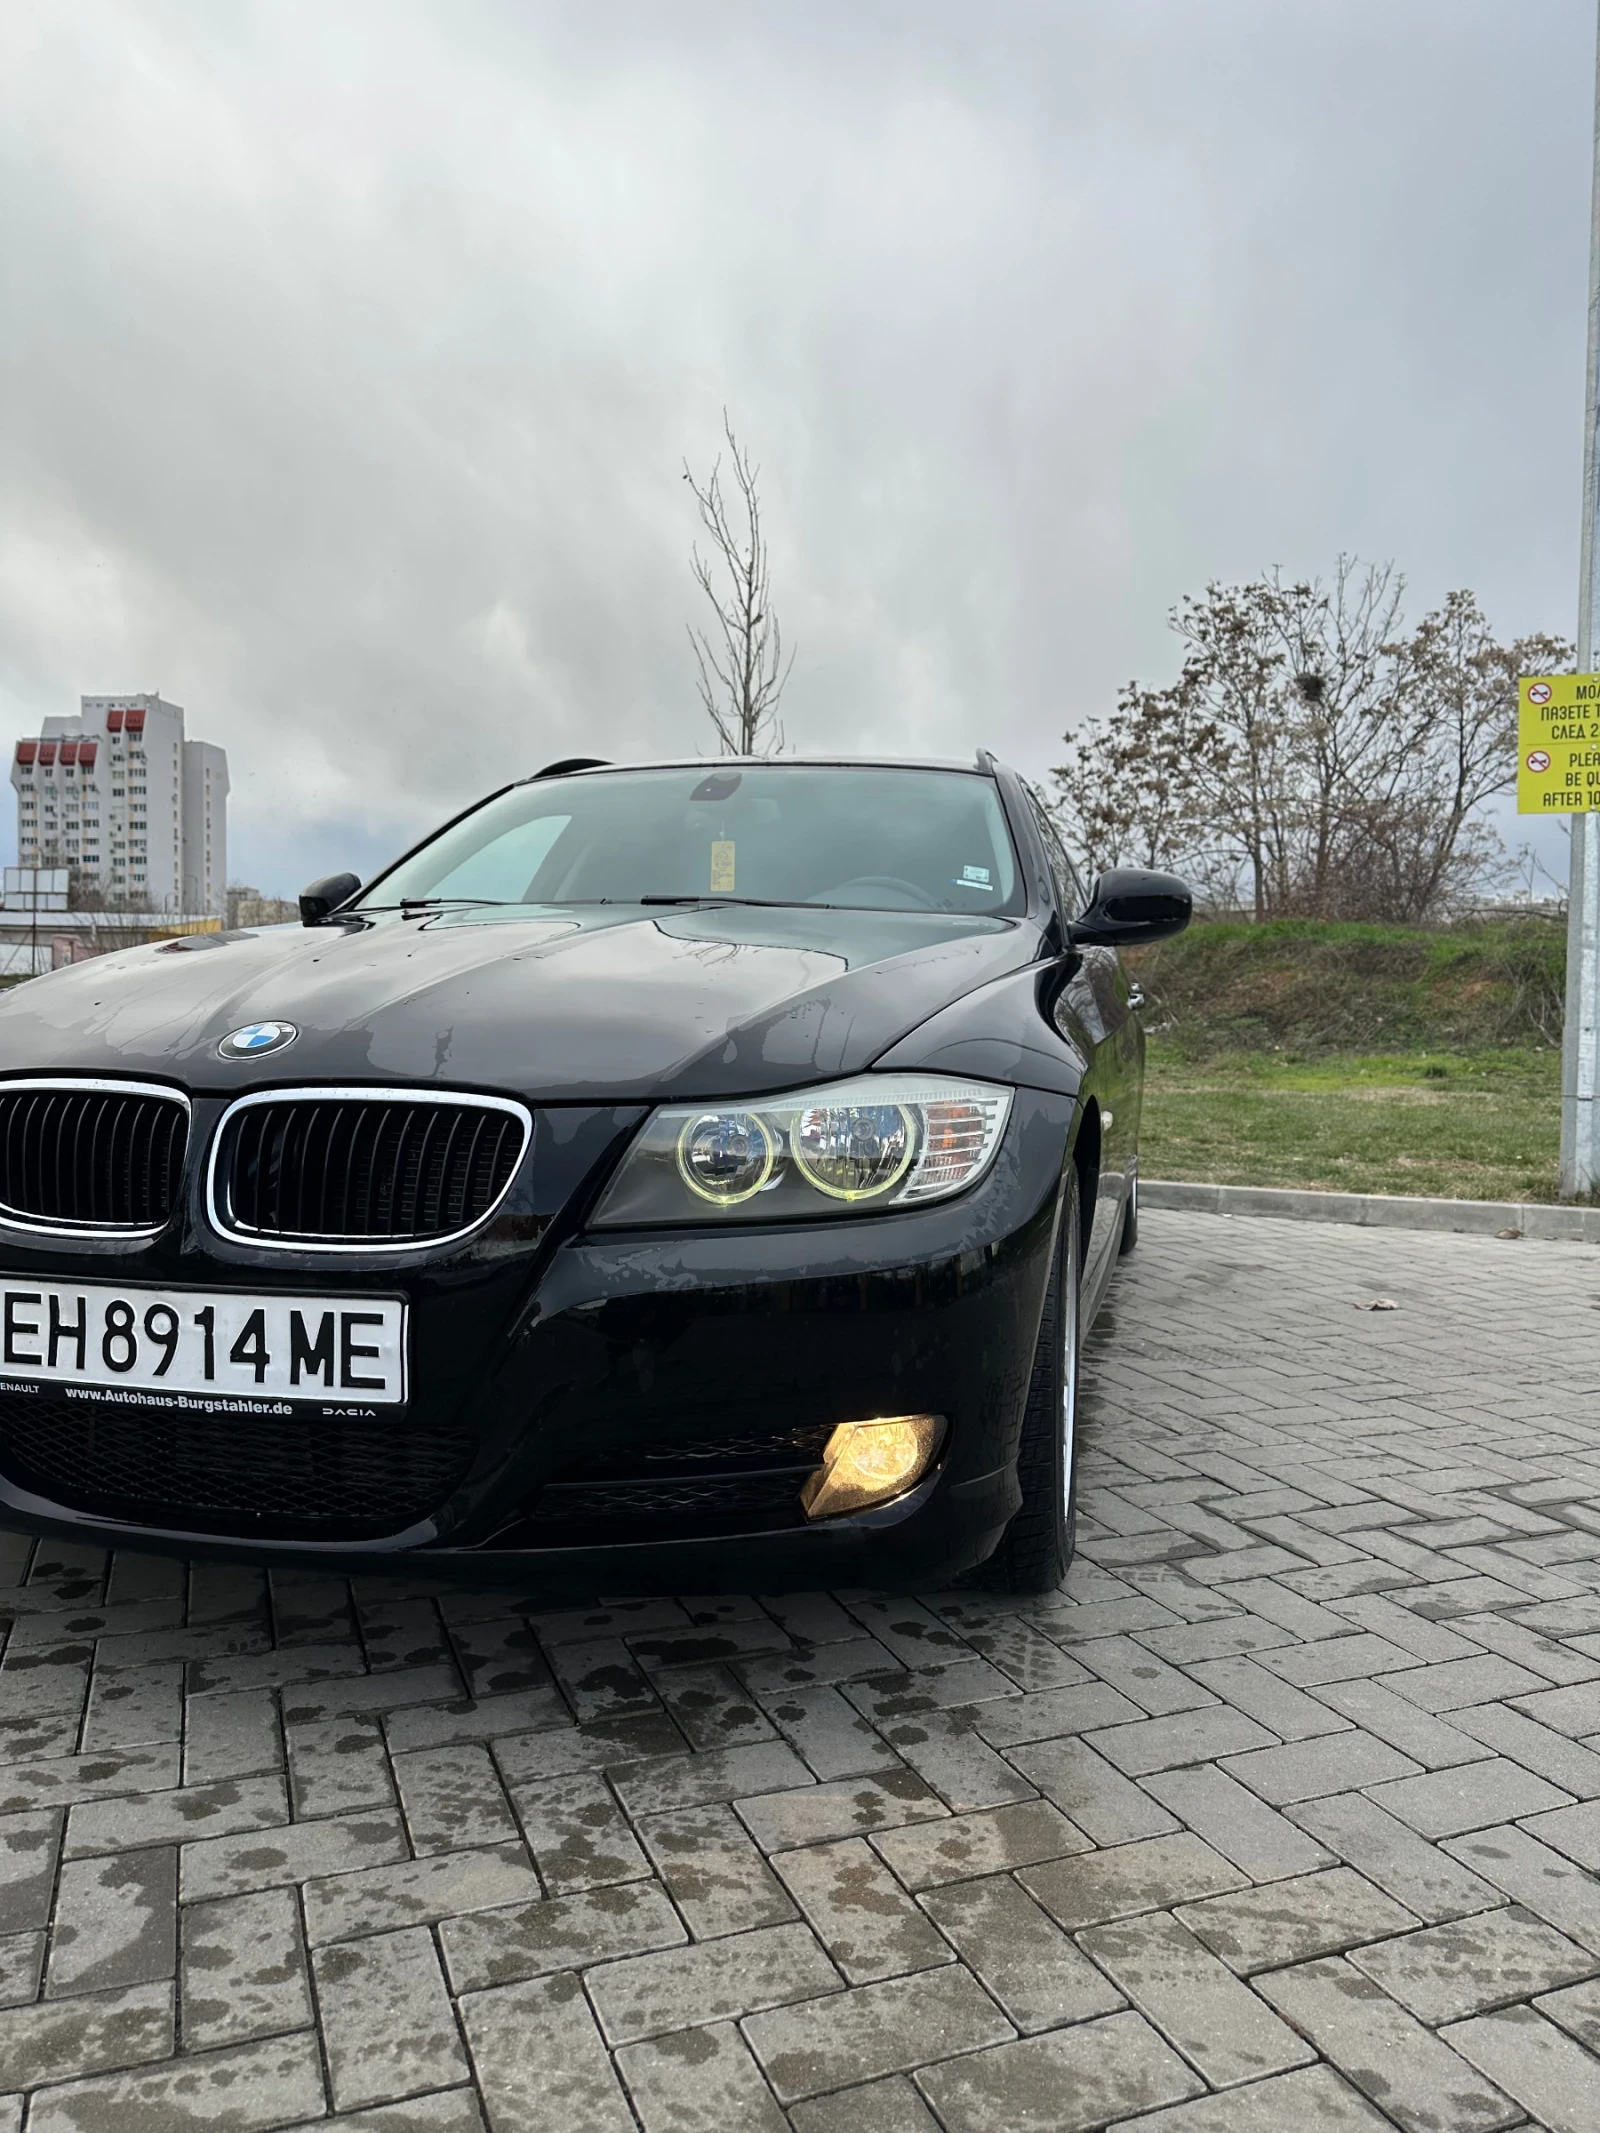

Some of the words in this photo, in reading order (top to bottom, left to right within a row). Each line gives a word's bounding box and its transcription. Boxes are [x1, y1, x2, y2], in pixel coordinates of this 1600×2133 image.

[1541, 704, 1590, 720] ПАЗЕТЕ
[1551, 724, 1586, 740] СЛЕД
[1566, 772, 1582, 787] BE
[1543, 791, 1582, 807] AFTER
[65, 1388, 293, 1415] www.Autohaus-Burgstahler.de
[322, 1407, 377, 1417] DACIA
